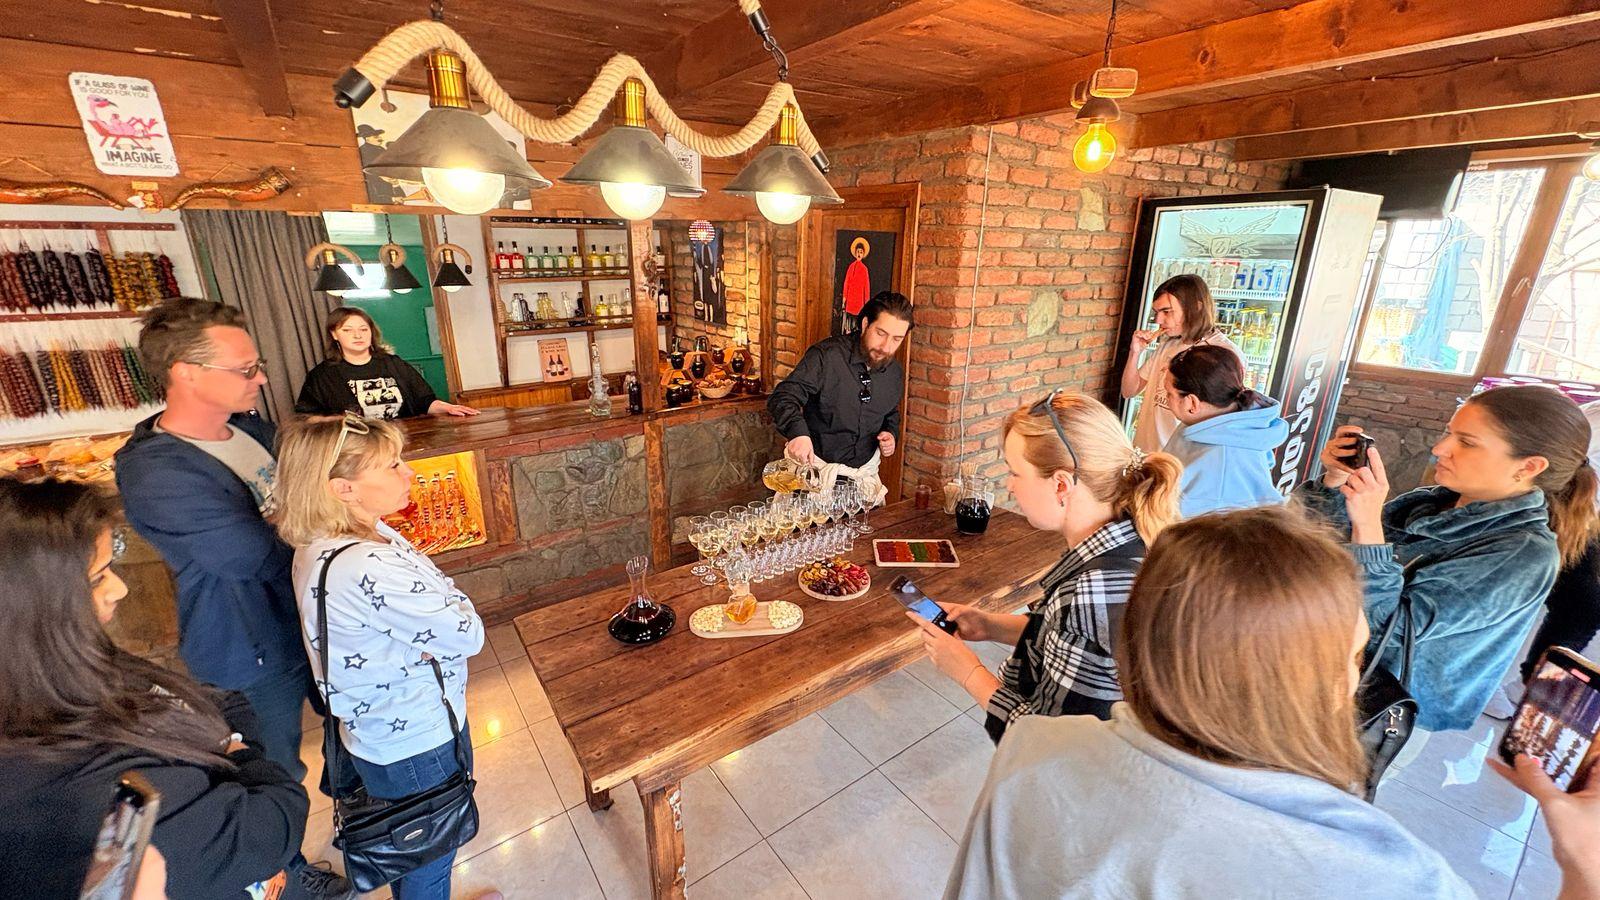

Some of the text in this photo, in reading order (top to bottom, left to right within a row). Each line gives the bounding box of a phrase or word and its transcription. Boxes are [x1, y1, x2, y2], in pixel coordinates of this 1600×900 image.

[88, 87, 113, 96] GOOD
[114, 89, 132, 98] FOR
[132, 90, 149, 99] YOU
[91, 80, 117, 89] GLASS
[118, 83, 128, 91] OF
[130, 84, 150, 93] WINE
[105, 150, 163, 164] IMAGINE
